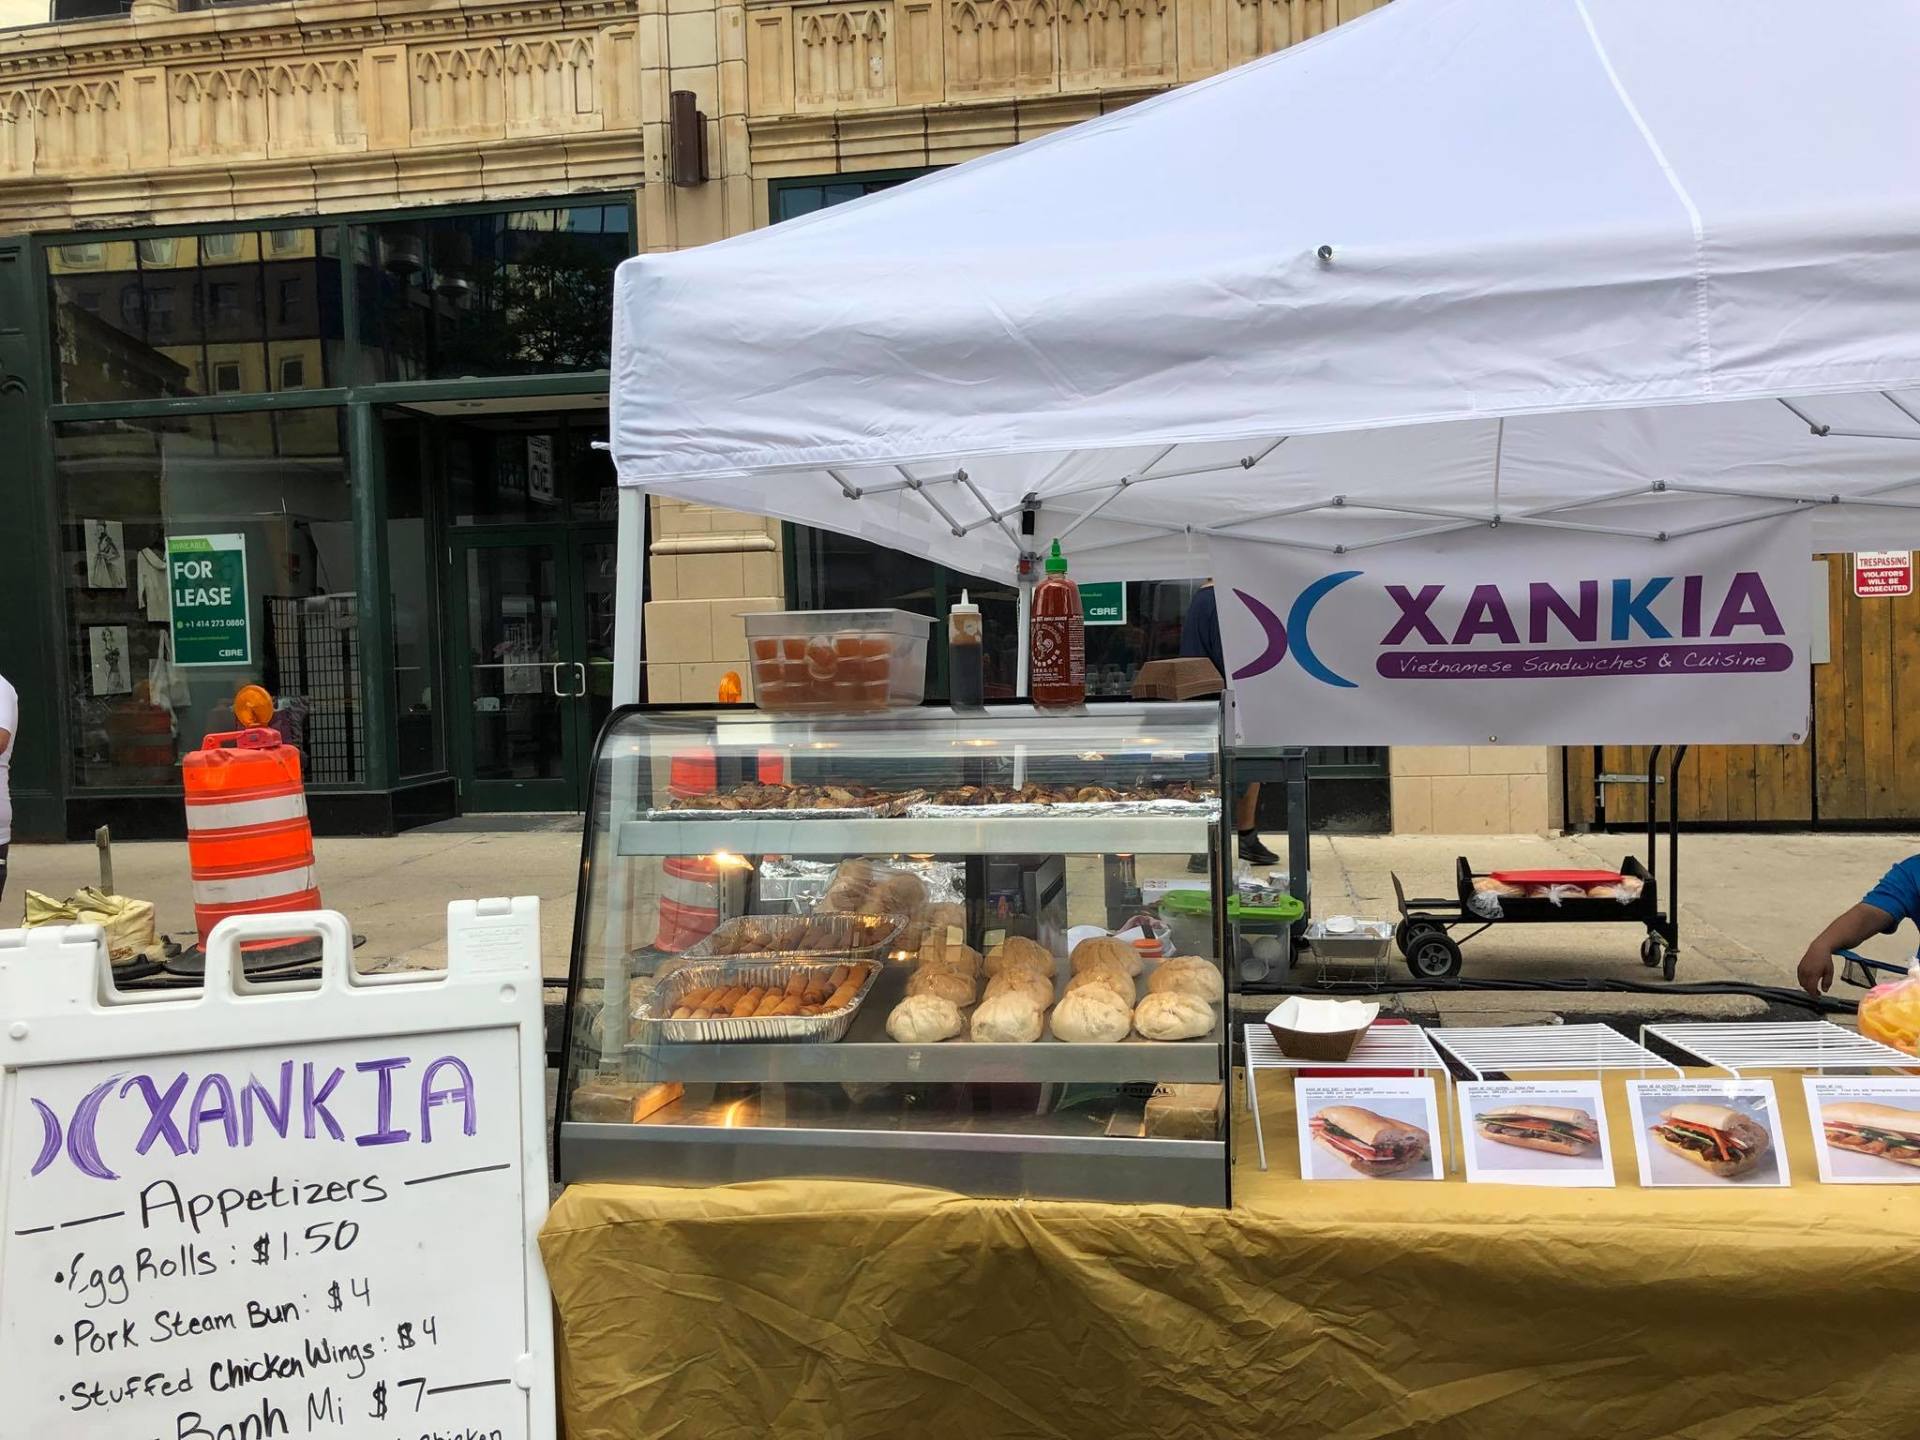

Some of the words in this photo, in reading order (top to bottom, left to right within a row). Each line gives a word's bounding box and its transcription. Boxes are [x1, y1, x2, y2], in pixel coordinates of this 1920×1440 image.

[173, 560, 213, 580] FOR
[1860, 557, 1907, 567] TRESPASSING
[1863, 570, 1904, 578] VIOLATORS
[175, 587, 232, 607] LEASE
[1379, 571, 1786, 645] XANKIA
[195, 620, 210, 628] 414
[211, 619, 224, 627] 273
[1090, 607, 1118, 616] CBRE
[219, 649, 243, 657] CBRE
[1399, 657, 1513, 674] Vietnamese
[1523, 653, 1647, 673] Sandwiches
[1658, 652, 1673, 667] &
[1683, 650, 1767, 668] Cuisine
[120, 1055, 477, 1157] XANKIA
[140, 1175, 388, 1234] Appetizers
[68, 1252, 129, 1308] Egg
[251, 1219, 360, 1266] $1.50
[74, 1318, 139, 1356] Pork
[150, 1309, 237, 1342] Steam
[247, 1294, 311, 1327] Bun:
[71, 1367, 193, 1412] Stuffed
[209, 1352, 305, 1392] Chicken
[305, 1336, 388, 1380] Wings:
[308, 1386, 344, 1433] Mi
